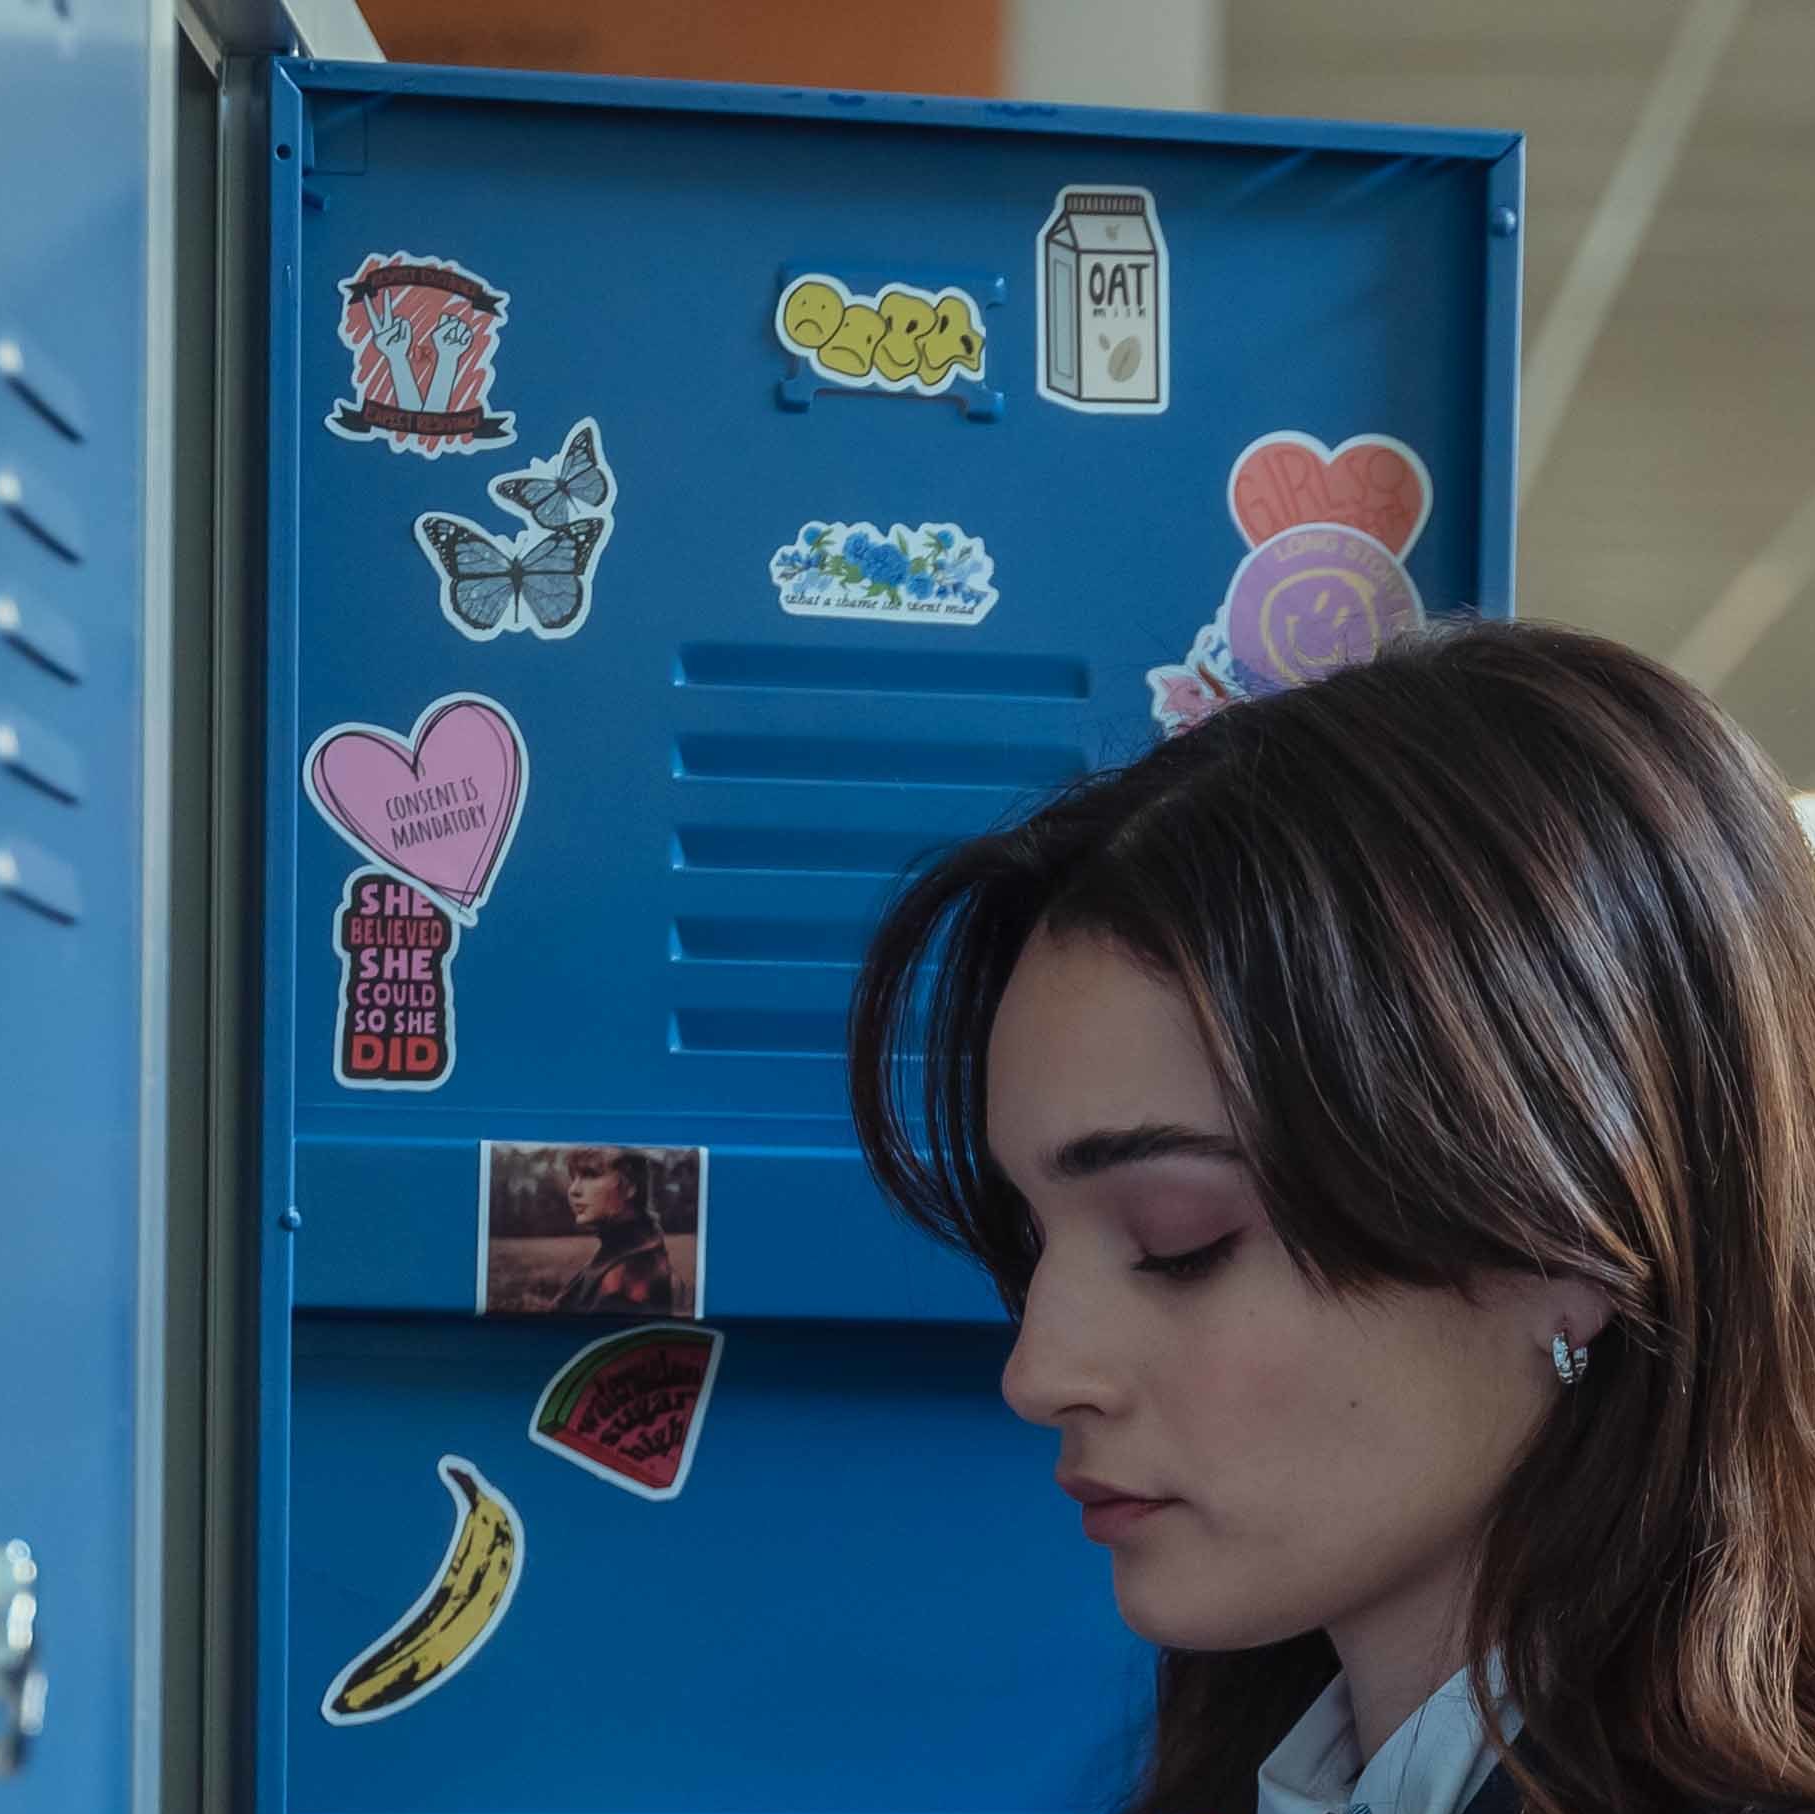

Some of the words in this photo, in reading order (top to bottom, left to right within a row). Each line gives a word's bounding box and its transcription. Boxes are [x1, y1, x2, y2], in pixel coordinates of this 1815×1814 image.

[1089, 262, 1150, 306] OAT
[386, 782, 455, 822] CONSENT
[461, 777, 479, 801] IS
[390, 804, 487, 850] MANDATORY
[360, 884, 434, 917] SHE
[351, 917, 443, 946] BELIEVED
[359, 948, 433, 981] SHE
[356, 982, 436, 1007] COULD
[354, 1009, 386, 1033] SO
[393, 1011, 436, 1034] SHE
[351, 1034, 439, 1072] DID
